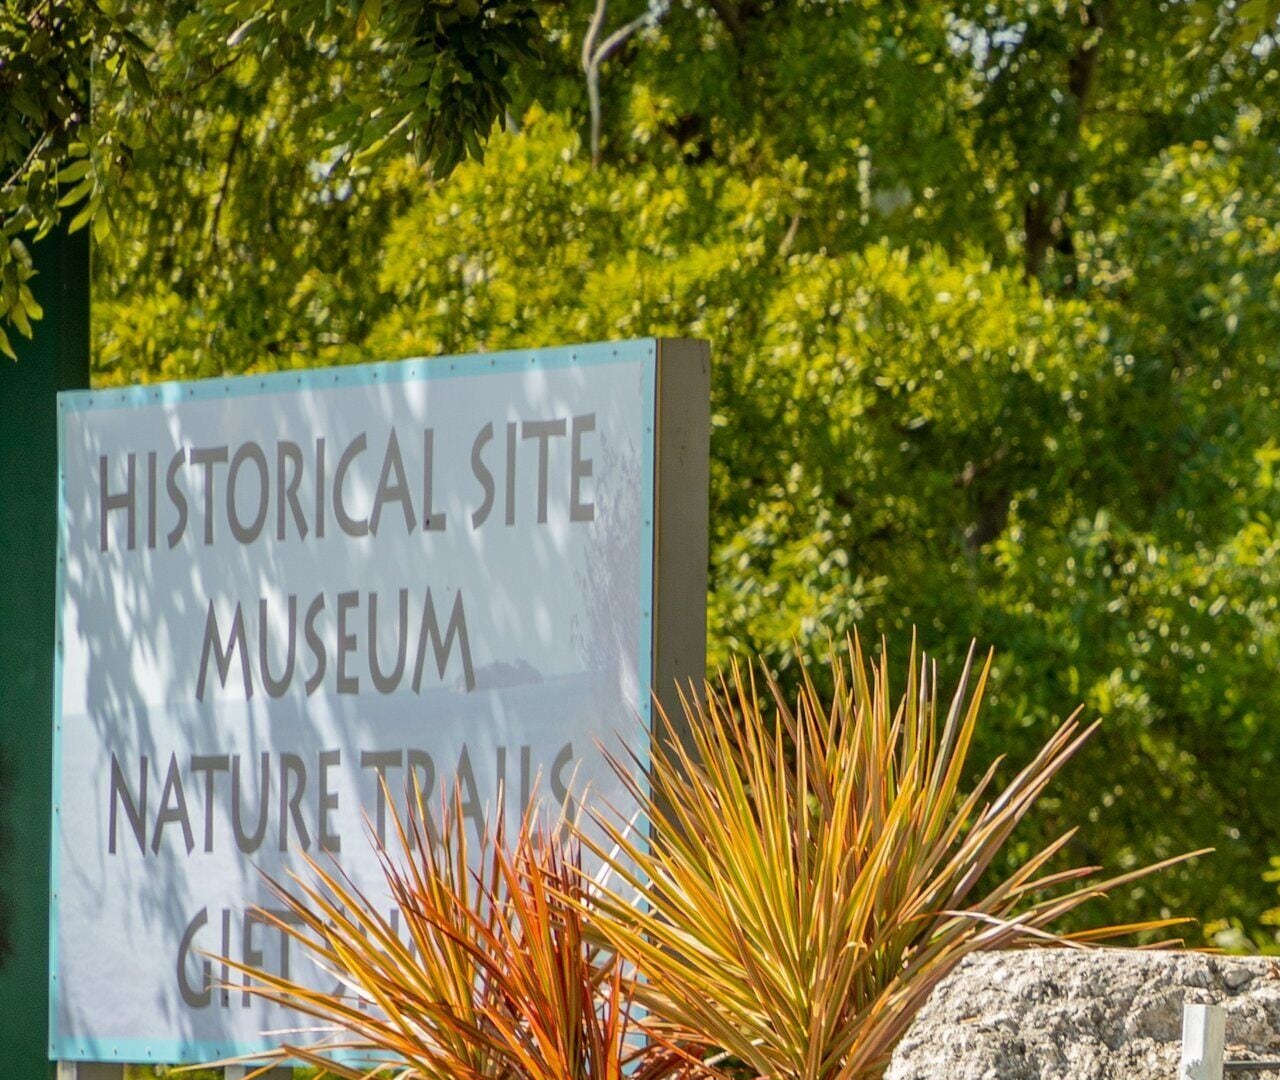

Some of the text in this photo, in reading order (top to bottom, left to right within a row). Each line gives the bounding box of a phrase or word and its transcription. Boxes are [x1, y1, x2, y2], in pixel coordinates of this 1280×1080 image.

[100, 413, 596, 552] HISTORICAL SITE
[196, 586, 476, 702] MUSEUM
[108, 741, 577, 857] NATURE TRAILS
[176, 904, 307, 1010] GIFT
